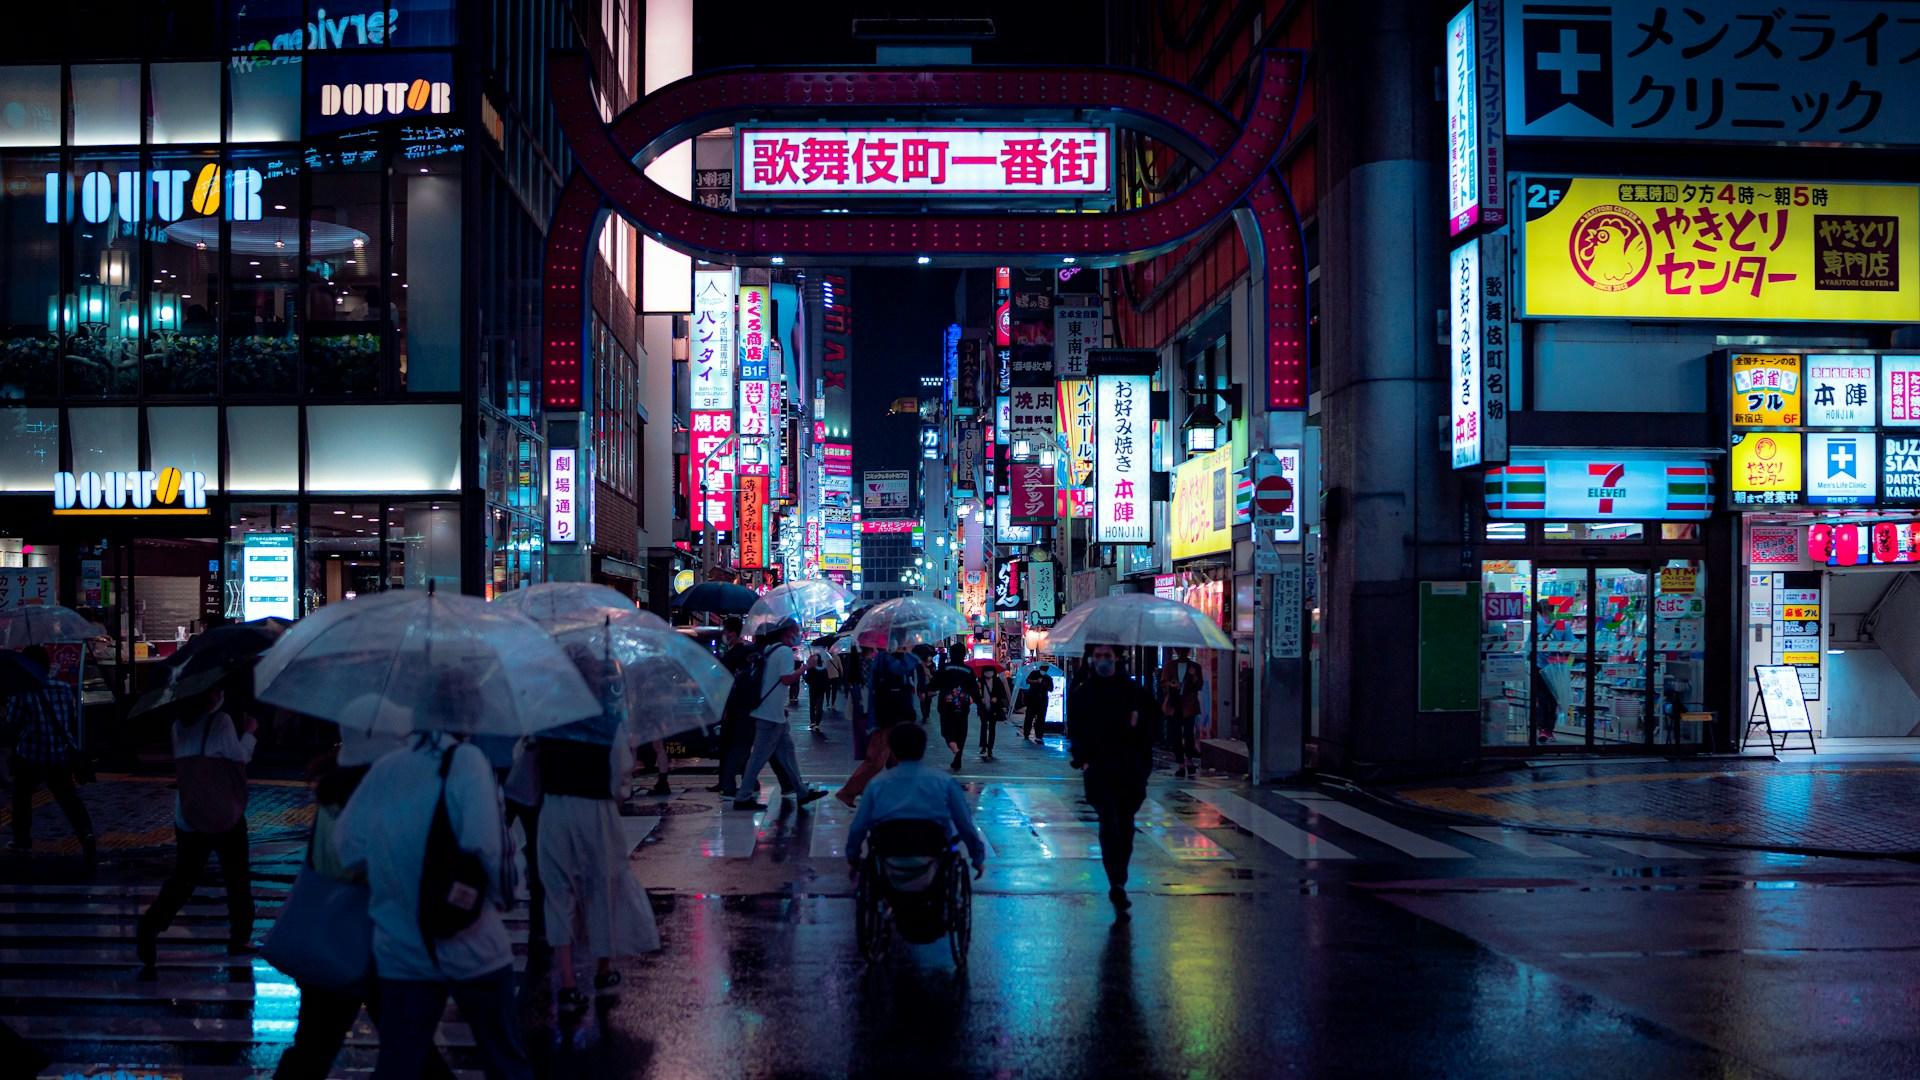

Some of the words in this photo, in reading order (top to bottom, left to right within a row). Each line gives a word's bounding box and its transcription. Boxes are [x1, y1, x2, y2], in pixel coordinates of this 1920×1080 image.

[1482, 21, 1502, 145] ファイトフィット
[320, 78, 451, 117] DOUTOR
[1627, 75, 1882, 133] クリニック
[753, 138, 1096, 185] 歌舞伎町一番街
[1527, 184, 1560, 213] 2F
[1620, 186, 1676, 206] 営業時間
[1652, 208, 1787, 257] やきとり
[1819, 220, 1896, 248] やきとり
[1823, 250, 1890, 278] 専門店
[1657, 253, 1796, 298] センター
[1861, 279, 1889, 287] CENTER
[746, 291, 762, 361] まぐろ商店
[696, 311, 717, 382] バンタイ
[1486, 276, 1503, 420] 歌舞伎町名物
[742, 366, 767, 377] B1F
[1735, 356, 1797, 367] 全国チェーンの店
[1752, 370, 1779, 387] 麻雀
[703, 398, 720, 408] 3F
[1015, 391, 1053, 411] 焼肉
[1814, 382, 1868, 407] 本陣
[693, 413, 732, 432] 焼肉
[1114, 380, 1133, 473] お好み焼き
[1735, 413, 1764, 424] 新宿店
[1783, 414, 1798, 425] 6F
[1885, 438, 1919, 456] BUZ
[746, 464, 763, 475] 4F
[1746, 461, 1783, 474] やきとり
[1885, 455, 1919, 472] STA
[53, 467, 208, 510] DOUTOR
[1747, 474, 1785, 486] センター
[556, 456, 571, 535] 劇場通り
[1114, 478, 1135, 523] 本陣
[1735, 491, 1798, 504] 朝まで営業中
[1104, 526, 1144, 538] HONJIN
[1661, 567, 1697, 576] ATM
[1488, 600, 1522, 616] SIM
[1656, 599, 1685, 612] たばこ
